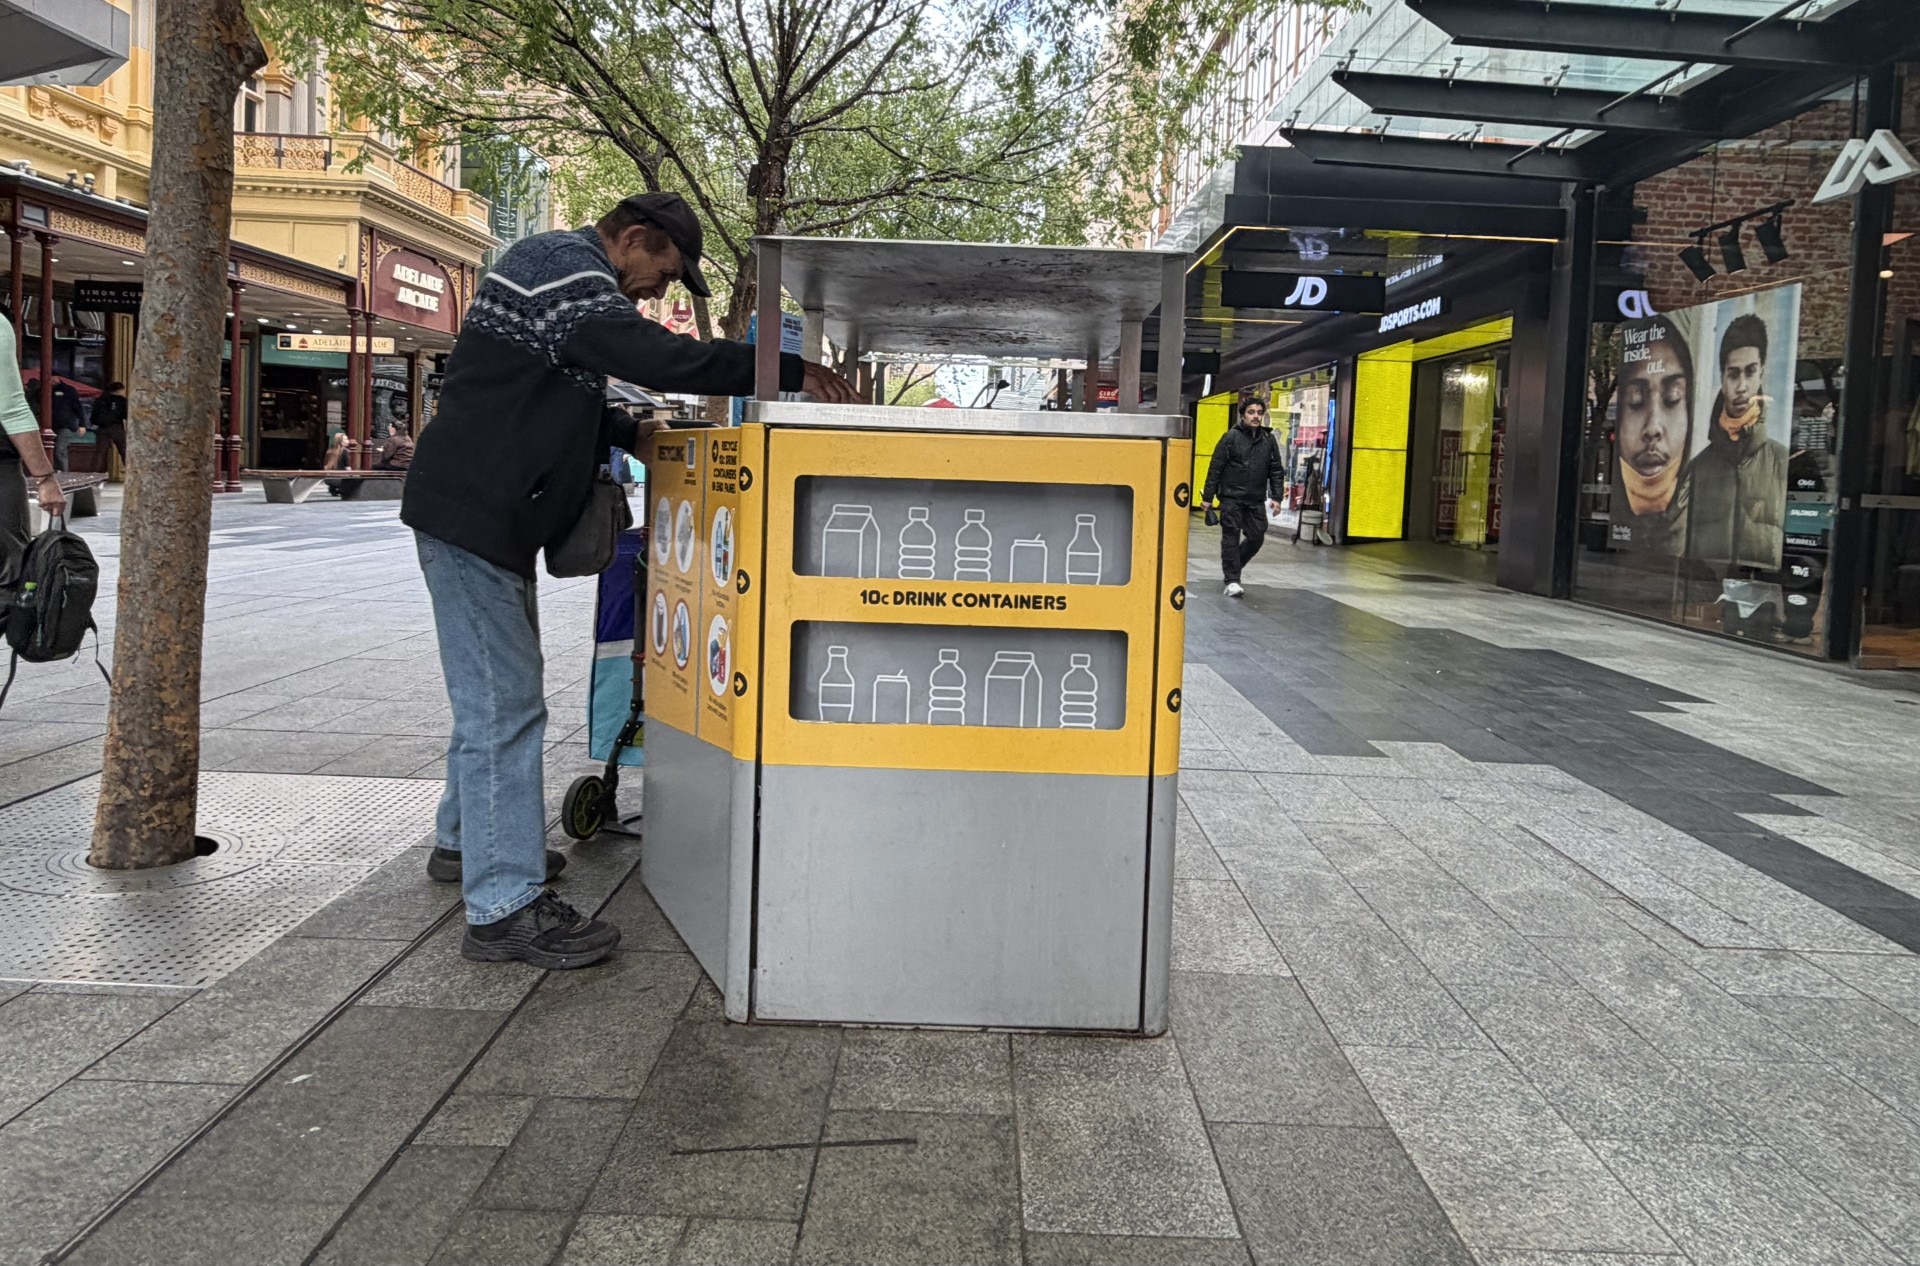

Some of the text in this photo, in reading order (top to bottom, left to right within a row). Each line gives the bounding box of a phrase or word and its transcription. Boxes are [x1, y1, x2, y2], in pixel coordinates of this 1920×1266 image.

[392, 264, 444, 294] ADELAIDE
[397, 286, 439, 312] ARCADE
[1284, 276, 1327, 306] JD
[1379, 296, 1441, 333] JDSPORTS.COM
[312, 338, 349, 347] ADELAID
[1624, 323, 1666, 345] Wear the
[1624, 344, 1651, 363] inside,
[1646, 359, 1665, 374] out.
[860, 590, 1067, 610] 10c DRINK CONTAINERS
